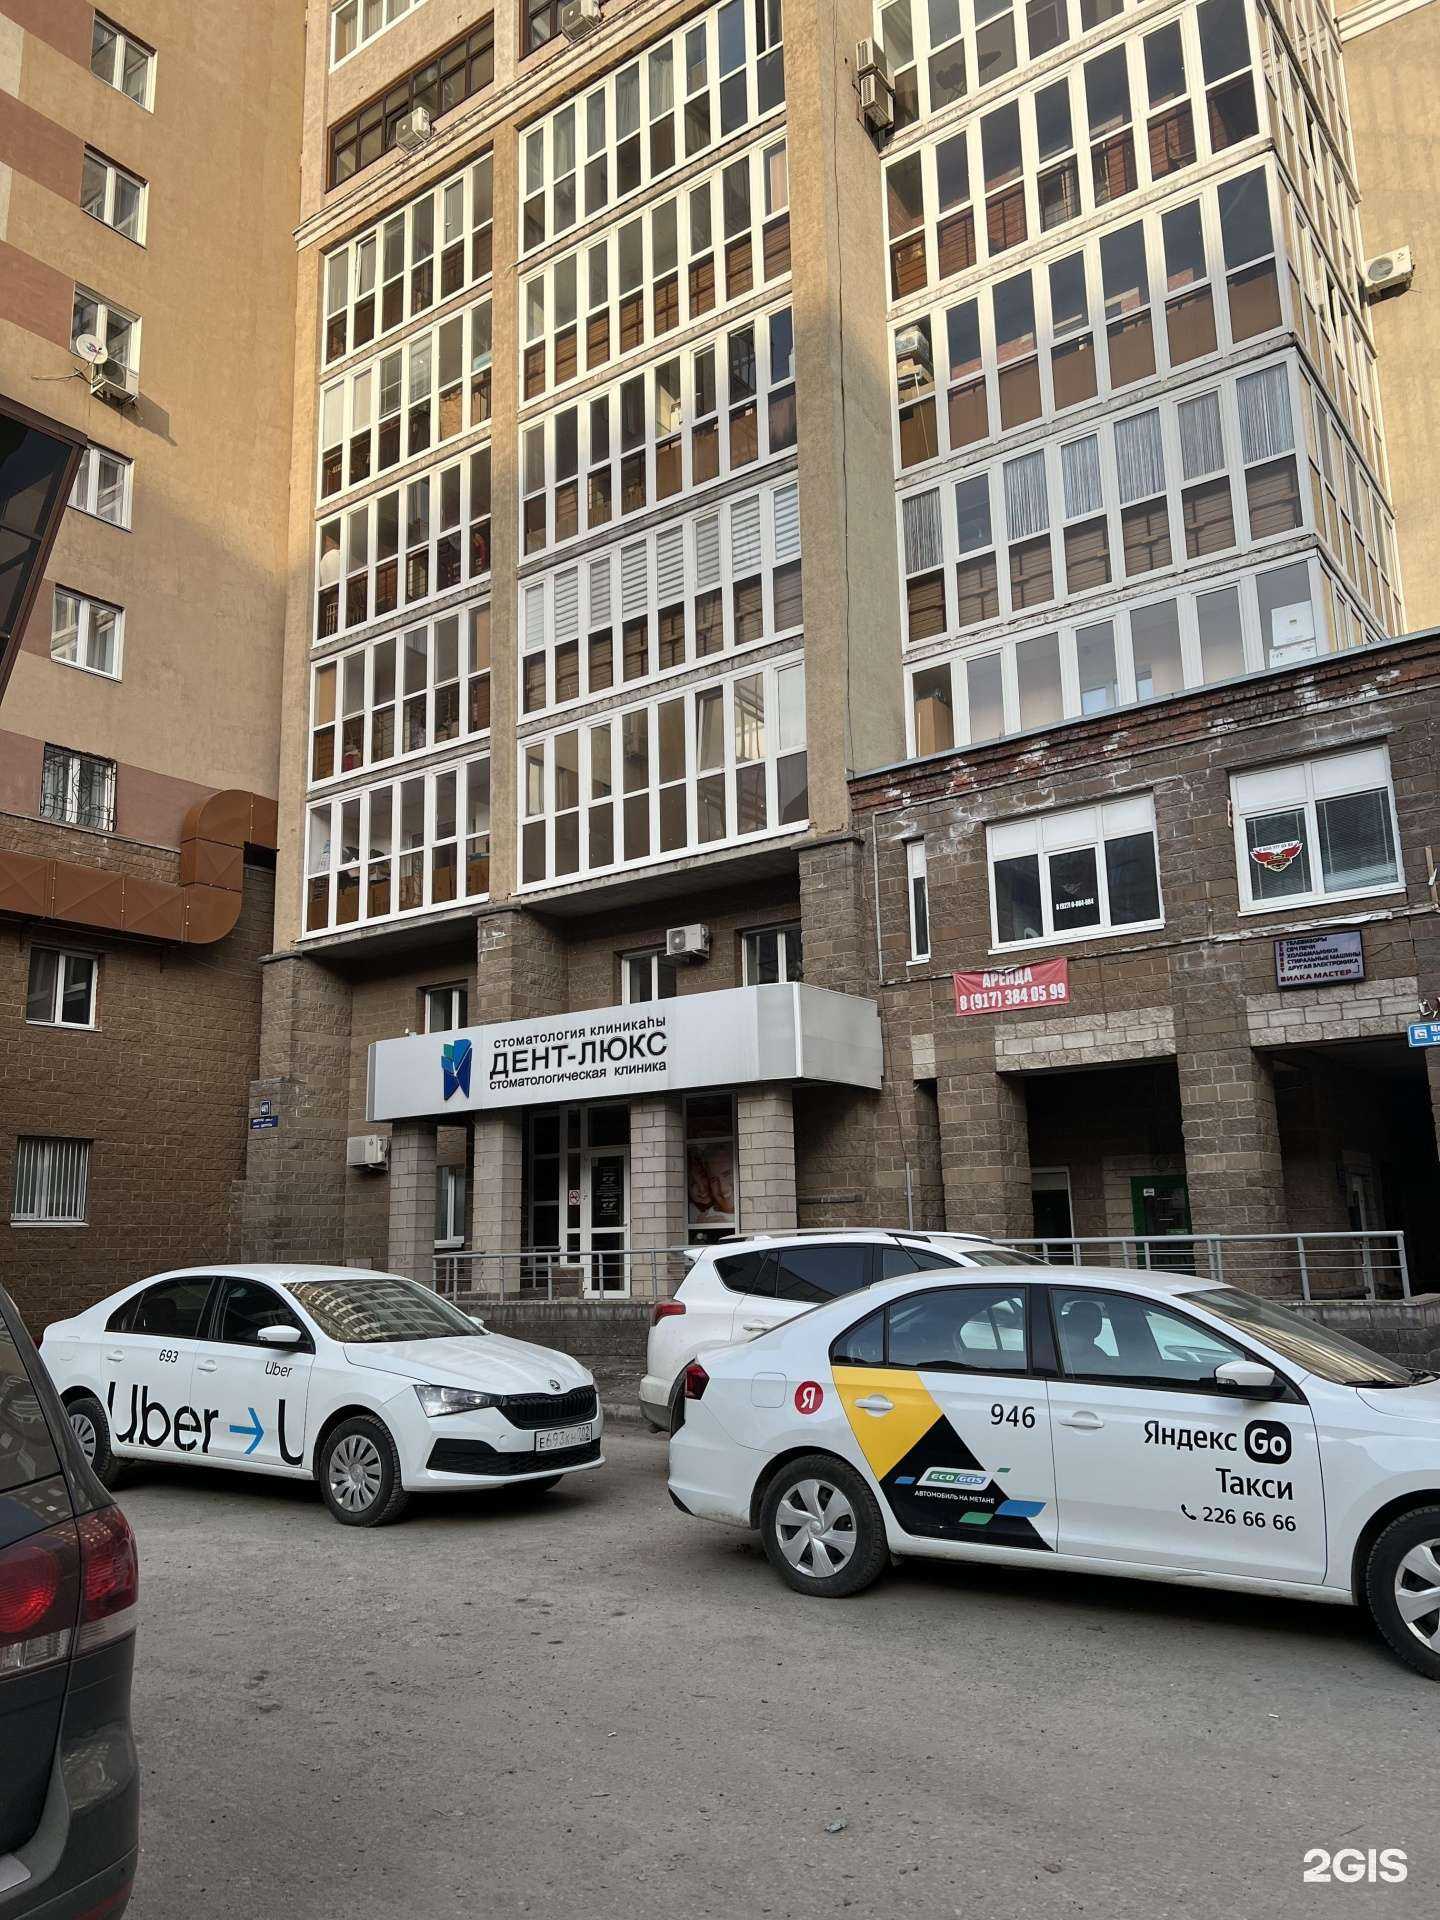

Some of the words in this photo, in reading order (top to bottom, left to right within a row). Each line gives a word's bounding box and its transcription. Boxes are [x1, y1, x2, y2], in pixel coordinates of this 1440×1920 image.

[982, 967, 1033, 988] АРЕНДА
[1280, 974, 1312, 982] ВИЛКА
[1314, 969, 1352, 978] МАСТЕР
[959, 995, 968, 1011] 8
[970, 991, 1002, 1011] (917)
[1005, 987, 1029, 1005] 384
[1030, 984, 1047, 1002] 05
[1049, 982, 1066, 999] 99
[493, 1028, 586, 1049] стоматология
[489, 1031, 668, 1080] ДЕНТ-ЛЮКС
[489, 1067, 607, 1090] стоматологическая
[614, 1060, 667, 1076] клиника
[158, 1349, 179, 1363] 693
[264, 1361, 293, 1378] Uber
[107, 1381, 219, 1453] Uber
[990, 1403, 1036, 1429] 946
[1144, 1420, 1238, 1451] Яндекс
[1249, 1427, 1288, 1457] Go
[914, 1490, 959, 1501] АВТОМОБИЛЬ
[969, 1496, 995, 1504] МЕТАНЕ
[1215, 1467, 1294, 1501] Такси
[1202, 1506, 1236, 1525] 226
[1242, 1510, 1266, 1528] 66
[1272, 1514, 1297, 1532] 66
